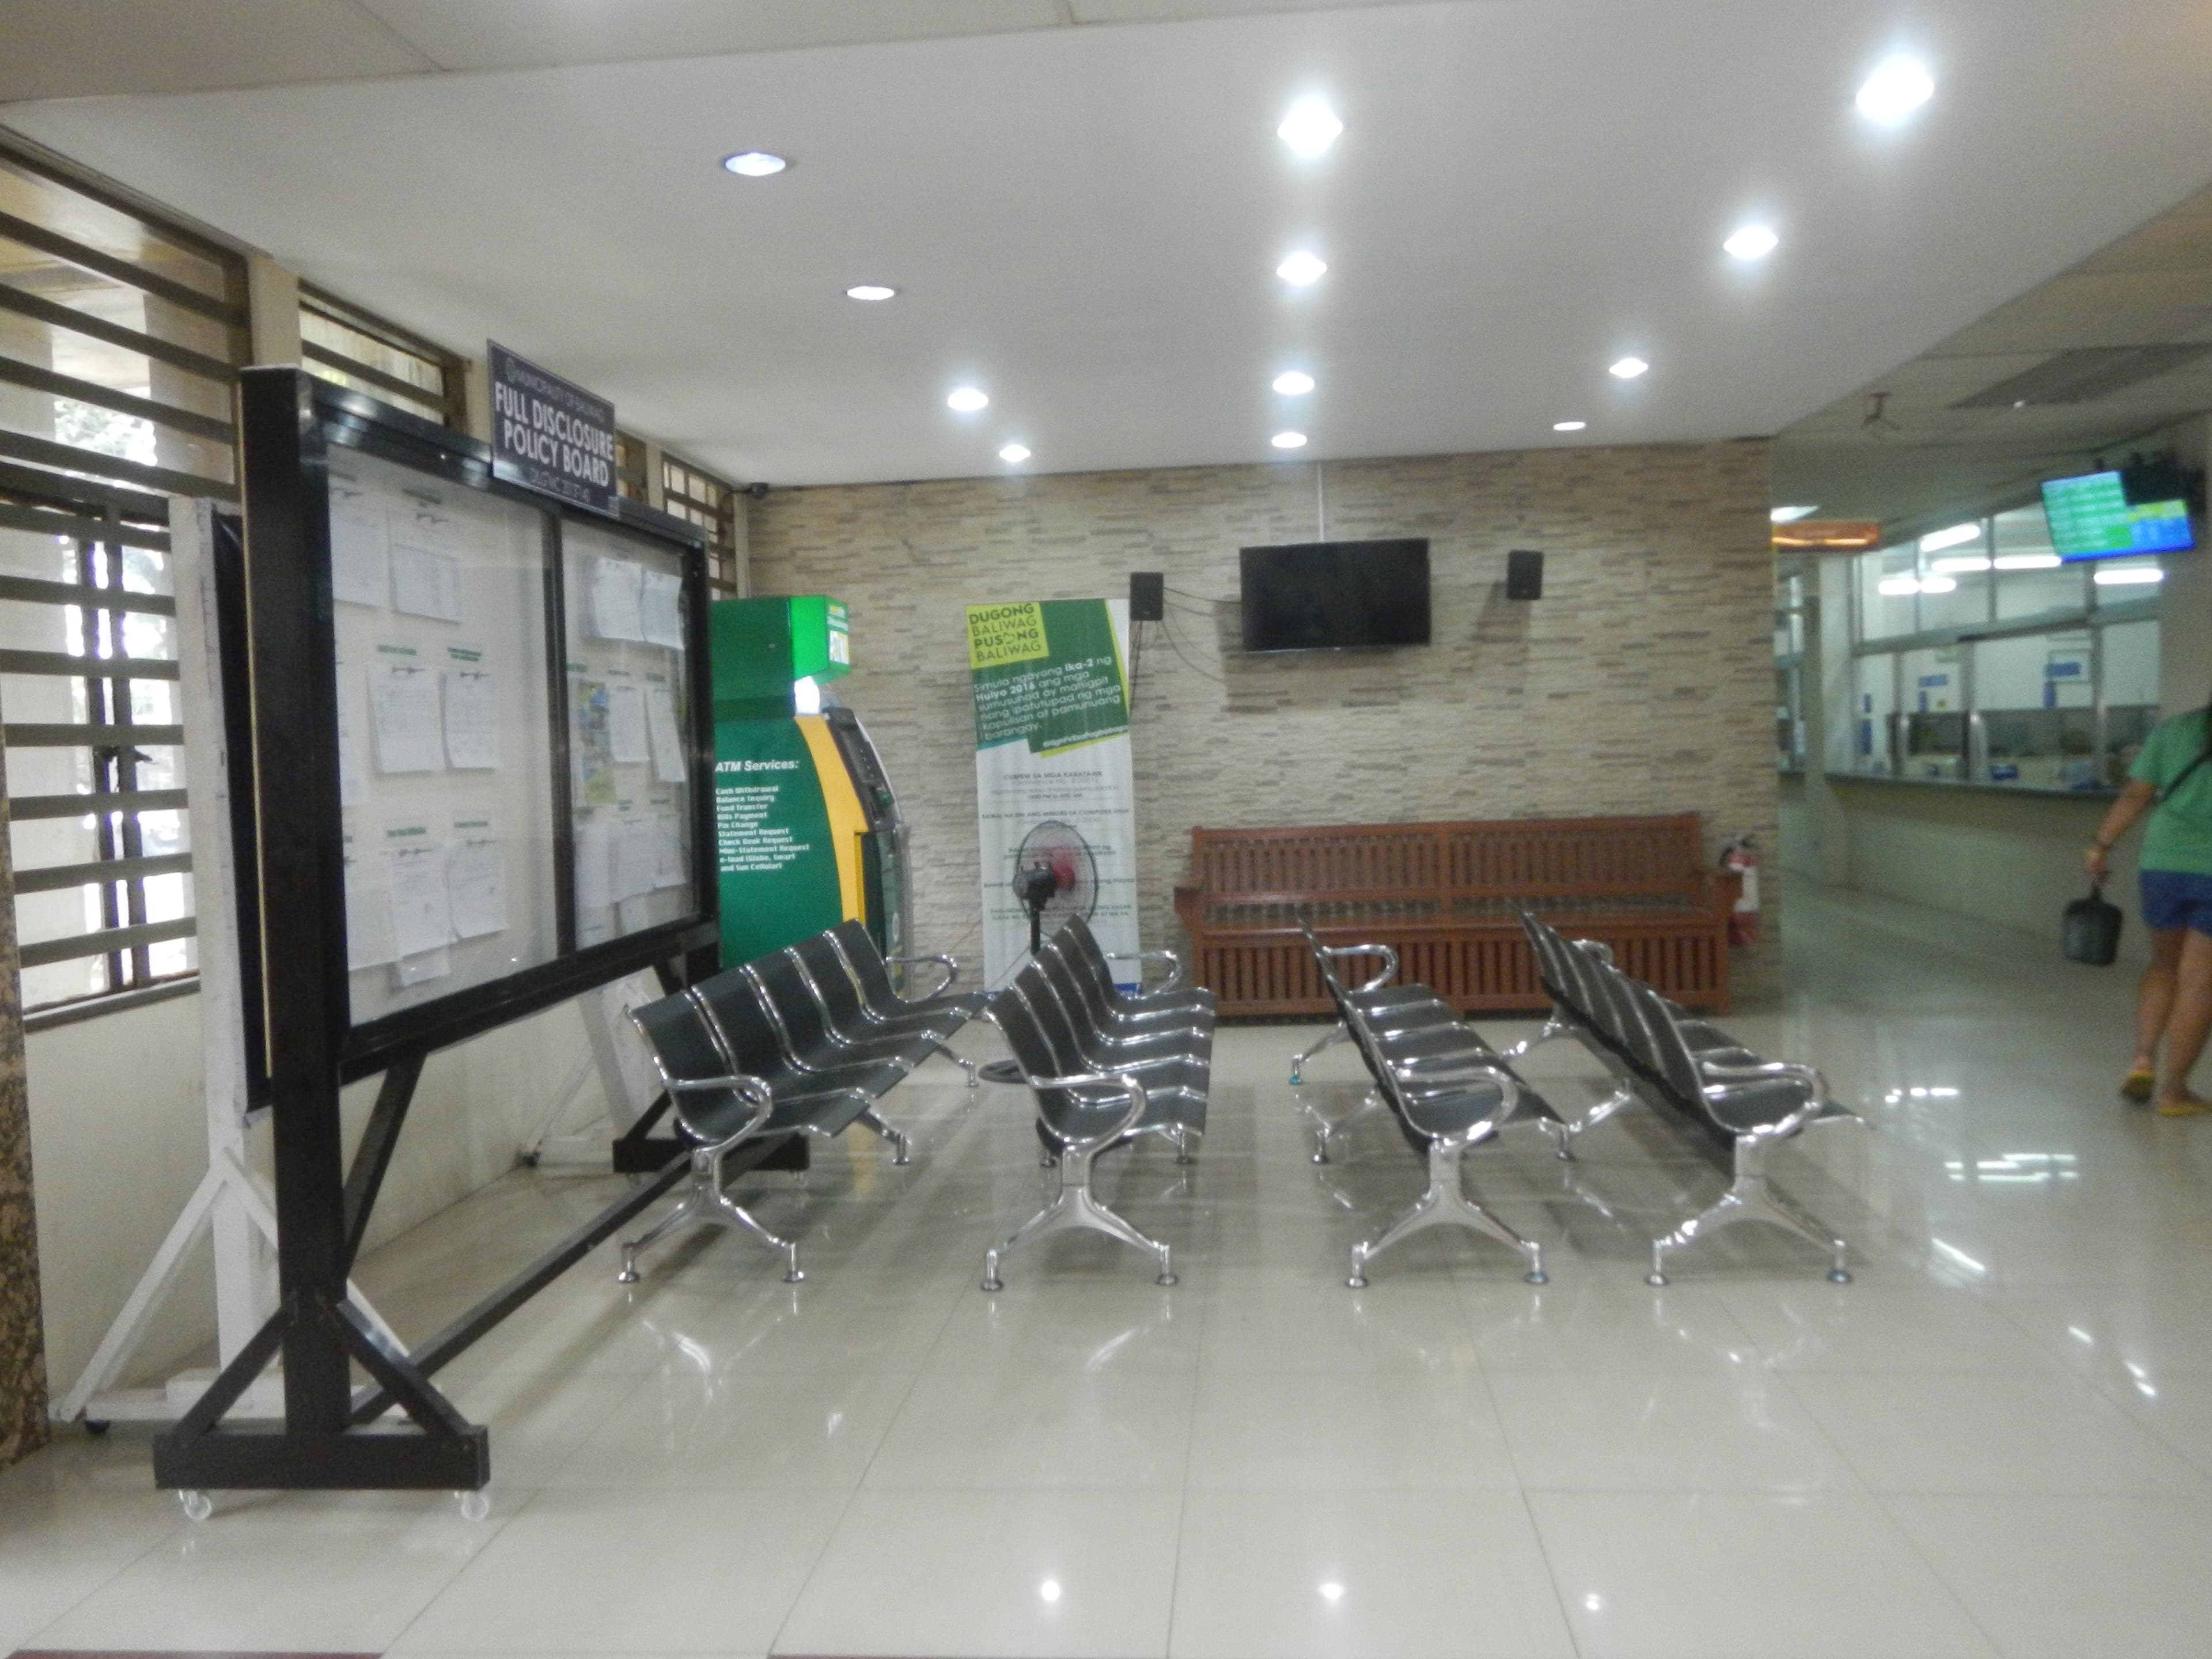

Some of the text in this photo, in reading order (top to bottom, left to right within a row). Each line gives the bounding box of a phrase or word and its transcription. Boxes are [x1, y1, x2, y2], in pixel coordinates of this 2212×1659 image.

[494, 381, 528, 425] FULL
[532, 399, 613, 461] DISCLOSURE
[504, 419, 558, 468] POLICY
[562, 444, 609, 487] BOARD
[969, 603, 1035, 624] DUGONG
[972, 615, 1037, 637] BALIWAG
[974, 628, 1039, 649] PUSONG
[976, 640, 1041, 662] BALIWAG
[974, 656, 1112, 692] Simula ngayong Ika-2 ng
[976, 671, 1090, 702] Hulyo 2016 ang mga
[1043, 689, 1056, 698] ay
[1059, 676, 1109, 692] mahigpit
[980, 709, 1009, 720] nang
[1078, 691, 1092, 700] ng
[1095, 684, 1121, 696] mga
[1036, 709, 1048, 718] at
[715, 759, 800, 772] ATM Services:
[735, 785, 779, 794] Withdrawal
[734, 812, 767, 820] Payment
[736, 803, 768, 812] Transfer
[718, 827, 789, 838] Statement Request
[762, 836, 793, 844] Request
[773, 853, 796, 861] Smart
[779, 843, 809, 852] Request
